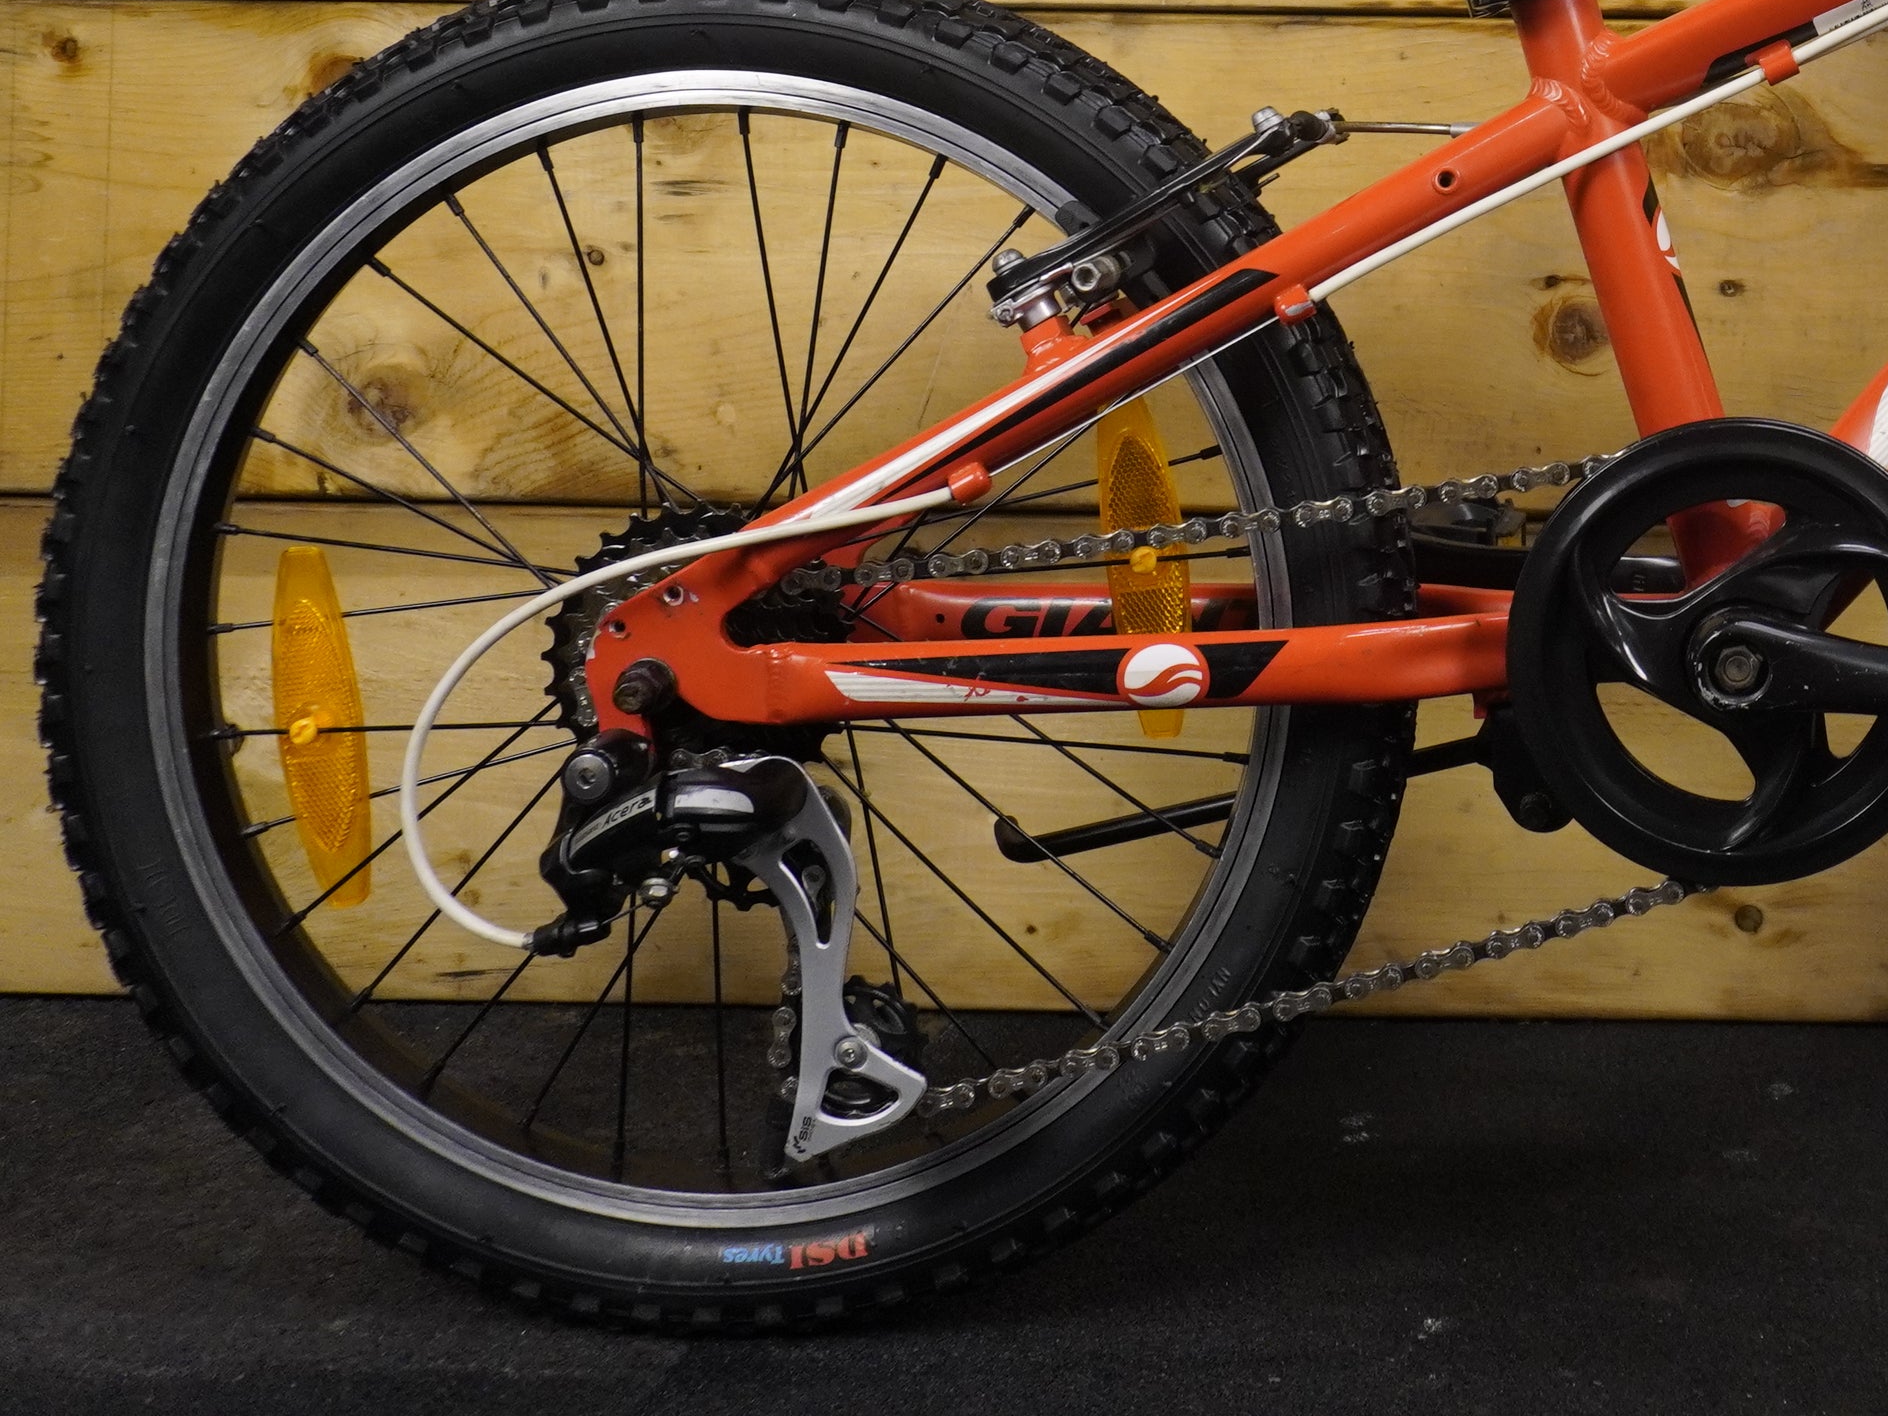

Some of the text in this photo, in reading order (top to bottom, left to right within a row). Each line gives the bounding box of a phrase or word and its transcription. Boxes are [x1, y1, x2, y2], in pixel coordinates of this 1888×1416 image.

[601, 796, 652, 830] Acera
[722, 1231, 868, 1270] DSI Tyres
